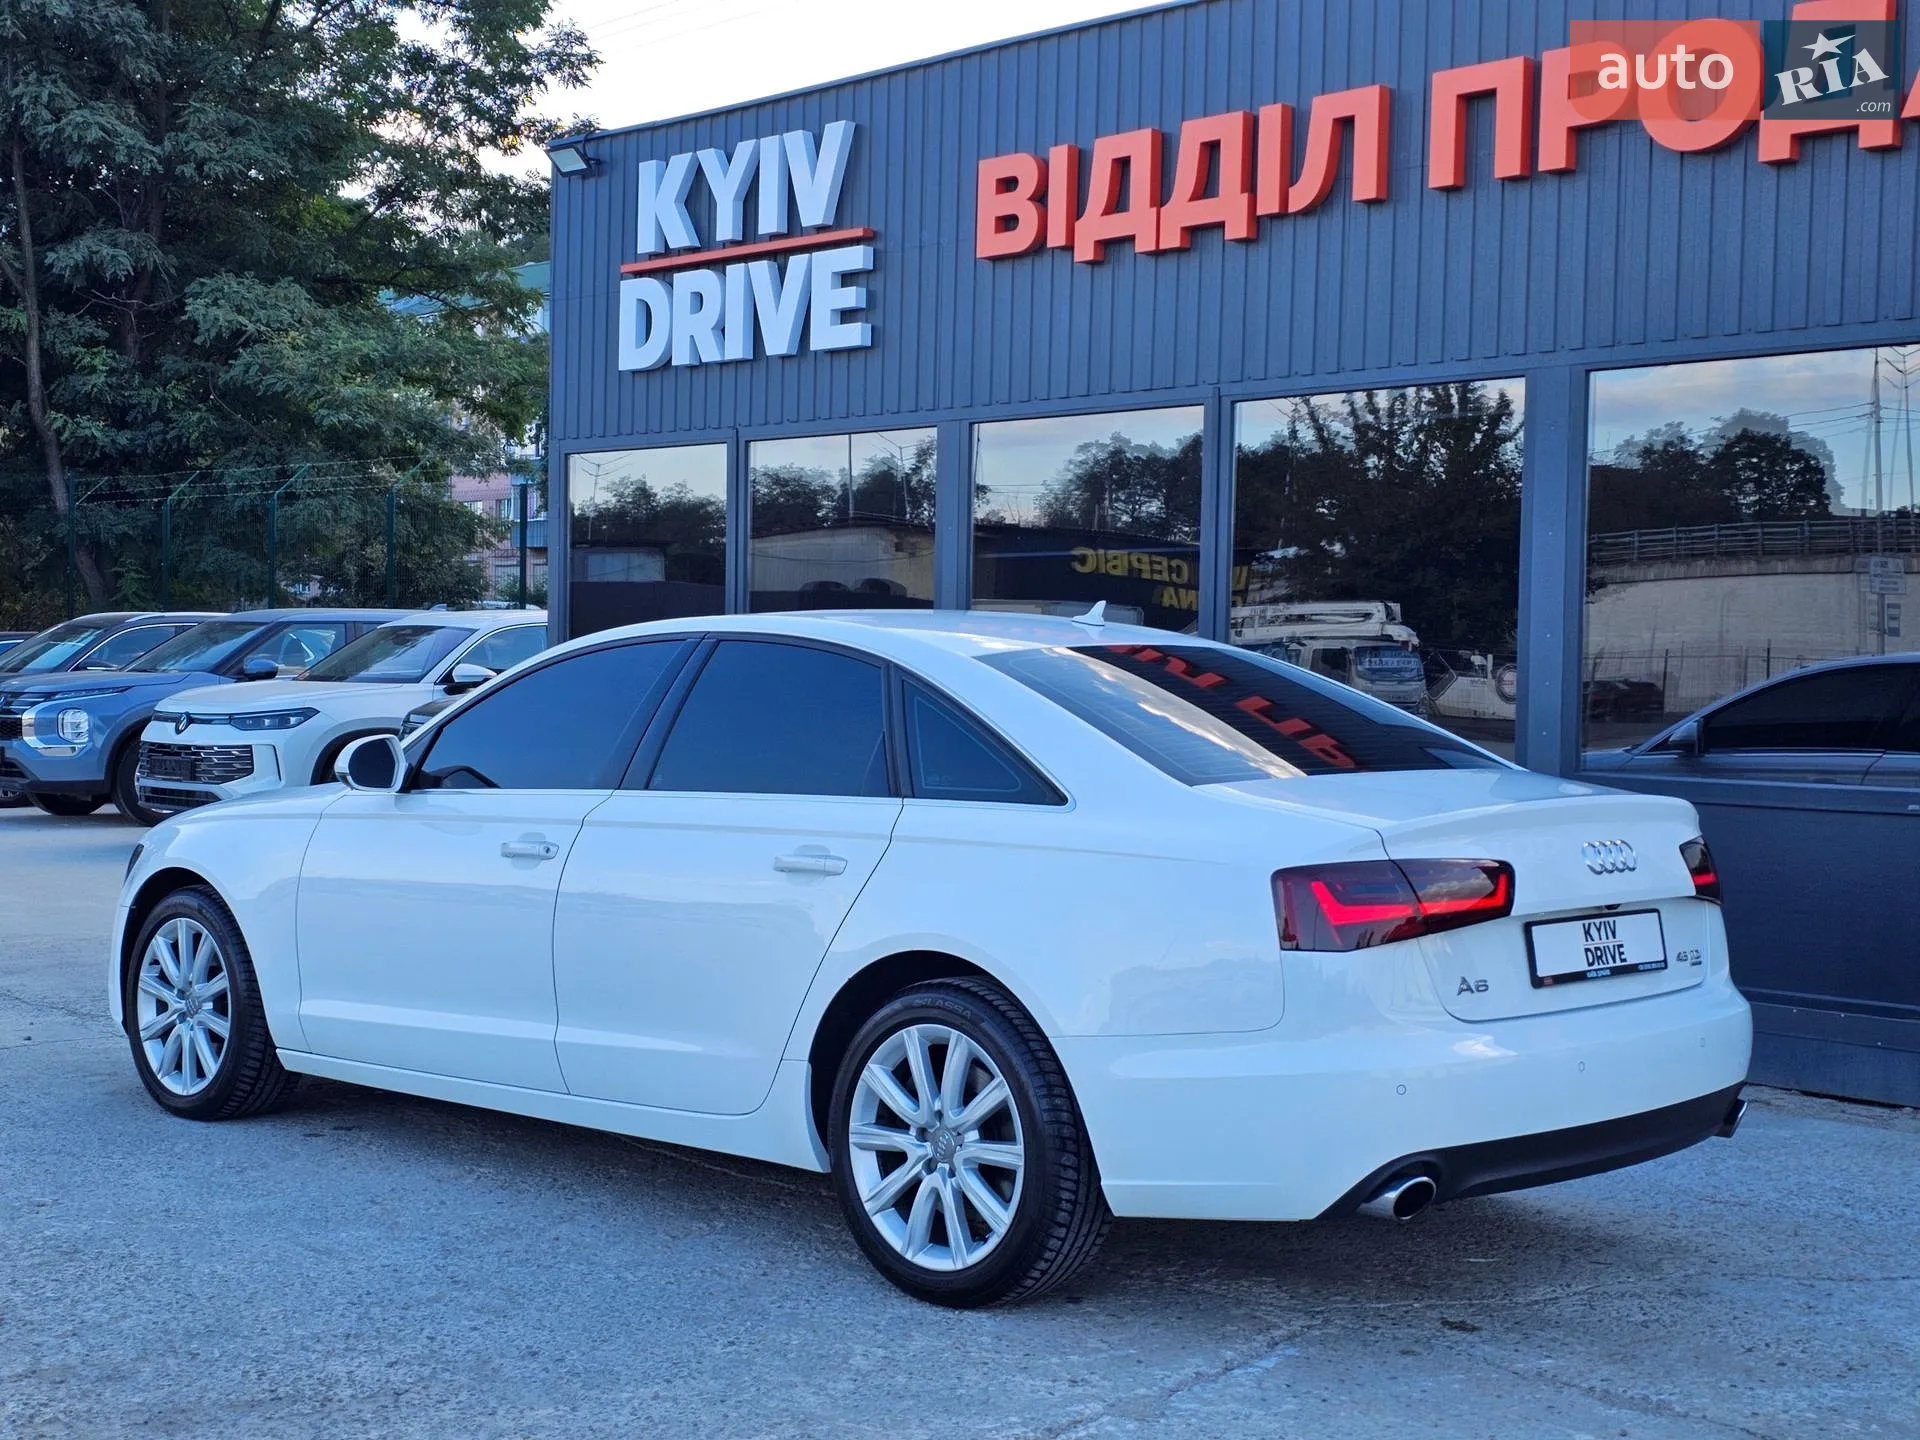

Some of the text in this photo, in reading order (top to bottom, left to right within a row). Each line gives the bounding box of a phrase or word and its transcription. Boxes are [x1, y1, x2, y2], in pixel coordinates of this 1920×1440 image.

[976, 0, 1920, 263] ВІДДІЛ ПРОД
[637, 120, 856, 254] KYIV
[619, 245, 874, 371] DRIVE
[1582, 920, 1617, 942] KYIV
[1583, 944, 1627, 967] DRIVE
[1457, 976, 1489, 996] A6
